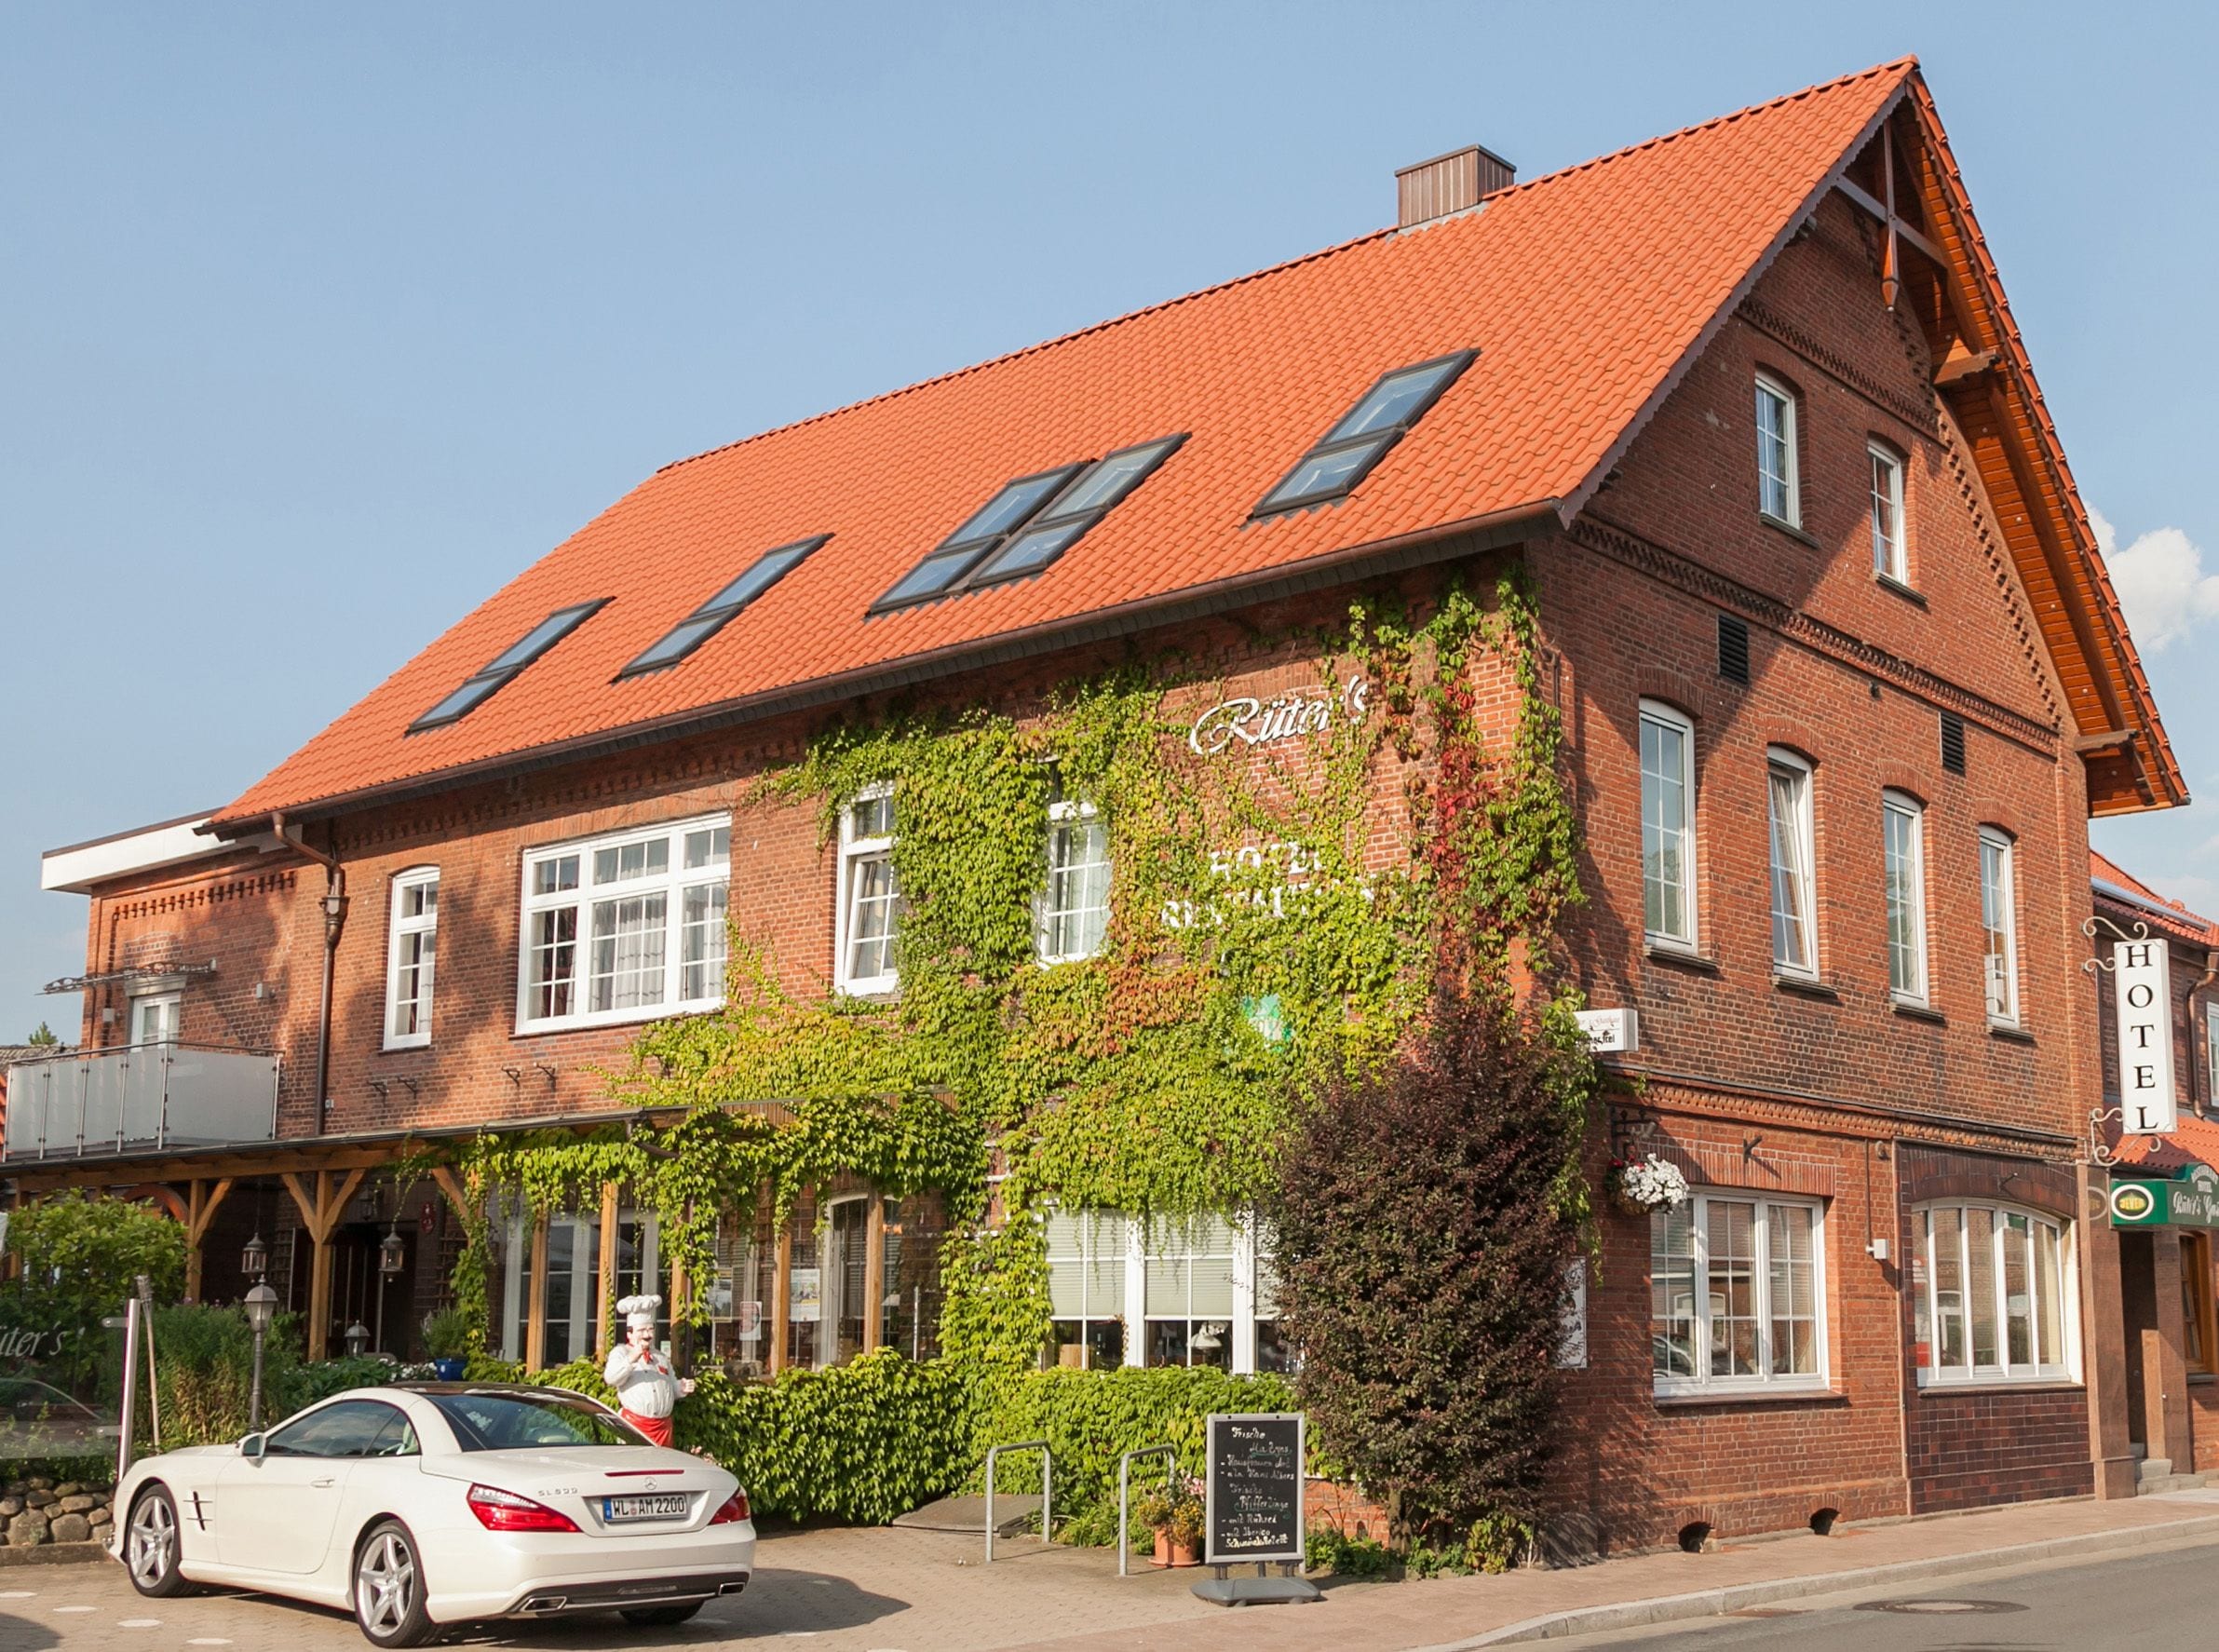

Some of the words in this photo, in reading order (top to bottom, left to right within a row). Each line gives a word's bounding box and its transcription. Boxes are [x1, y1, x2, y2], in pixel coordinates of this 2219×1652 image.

[2124, 944, 2158, 1131] HOTEL
[1231, 1427, 1266, 1439] Frische
[613, 1499, 629, 1516] WL
[639, 1498, 654, 1515] AM
[656, 1496, 685, 1513] 2200
